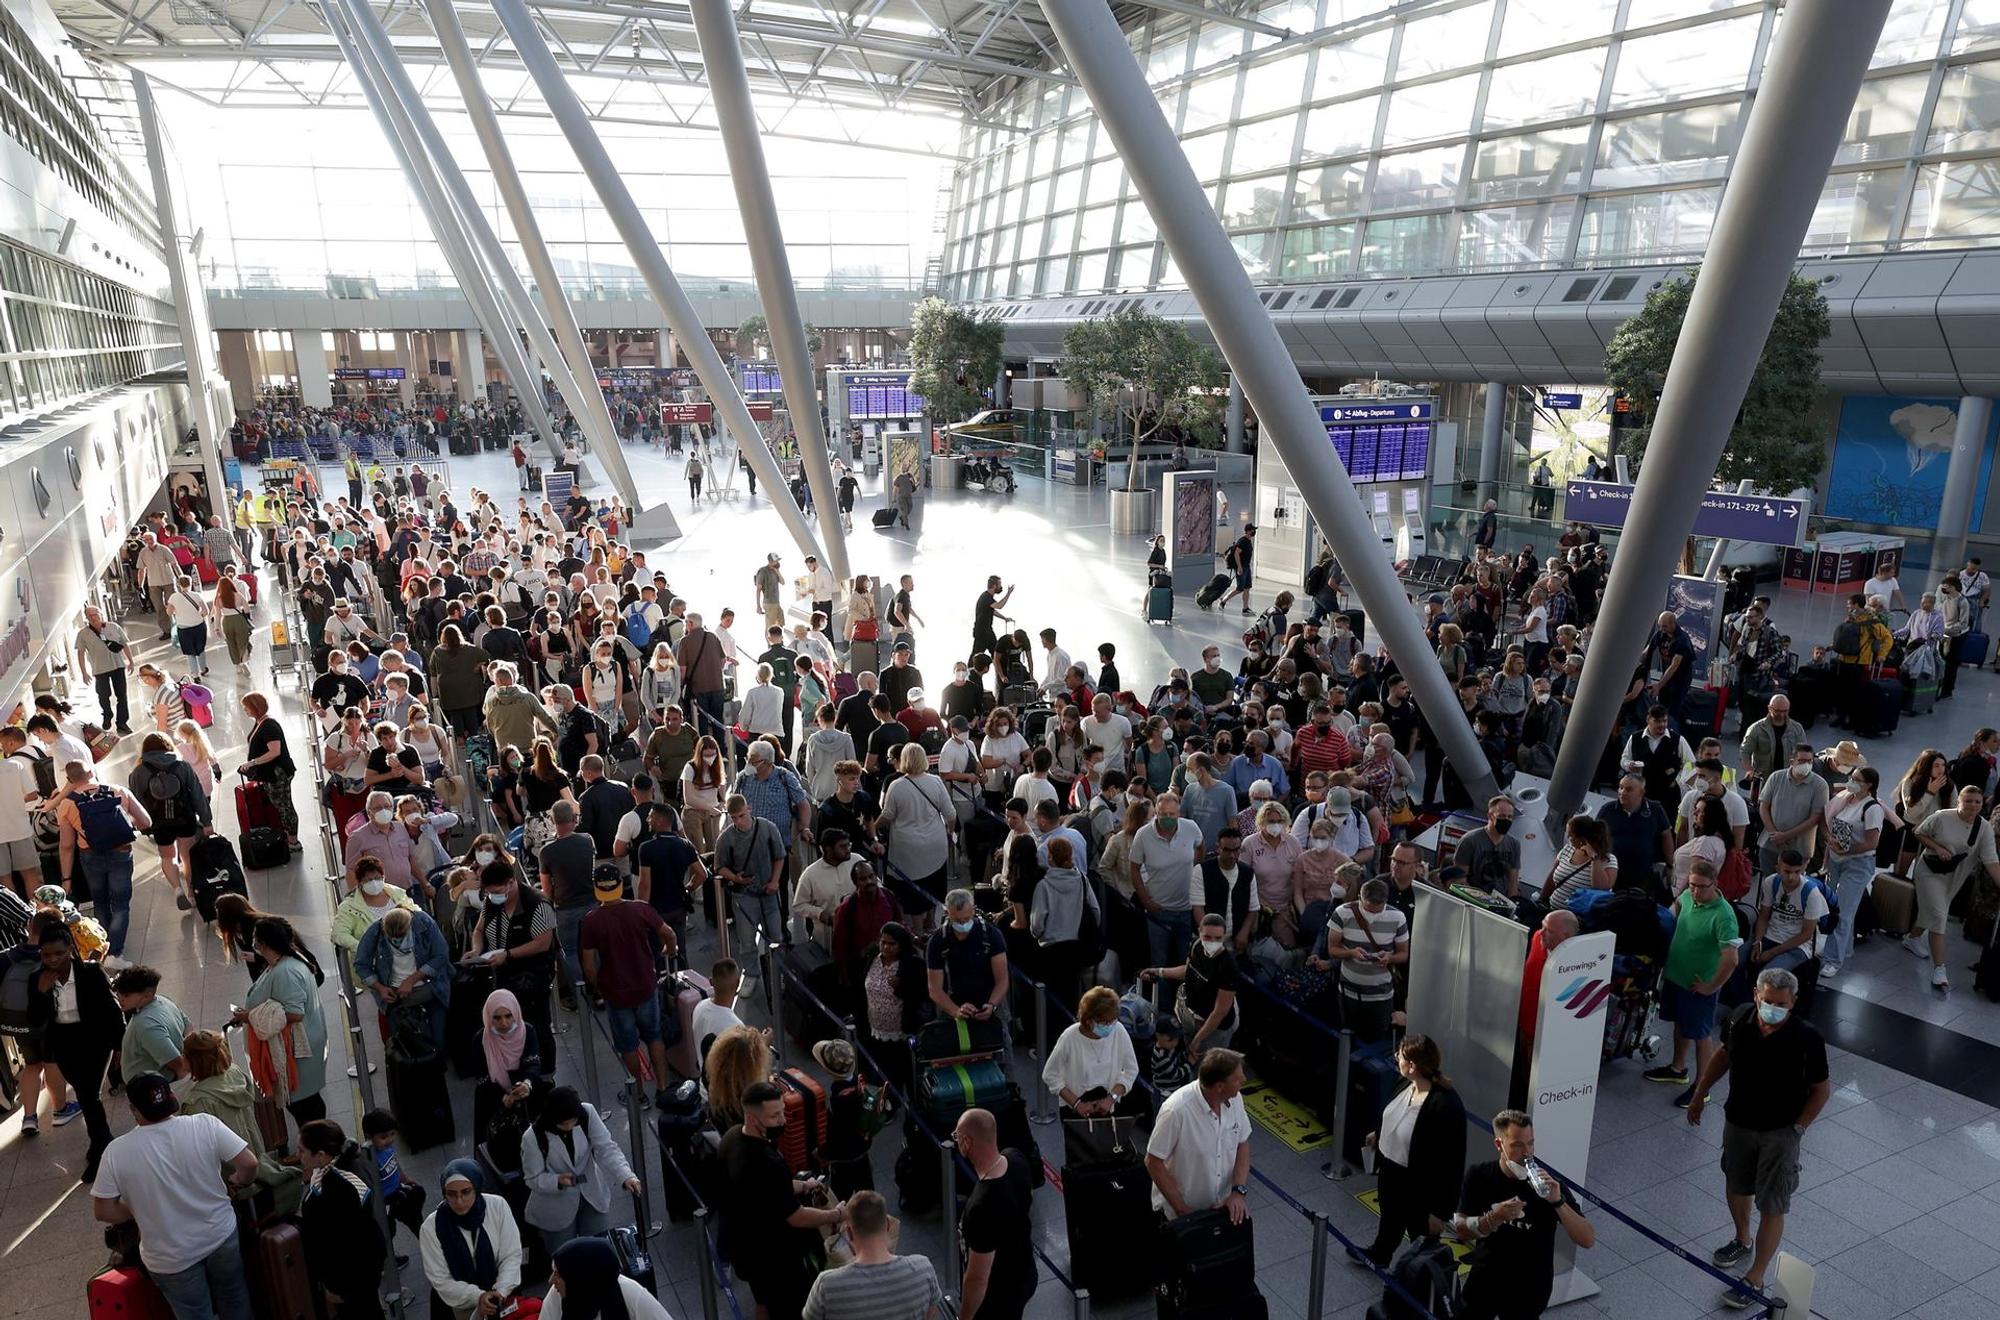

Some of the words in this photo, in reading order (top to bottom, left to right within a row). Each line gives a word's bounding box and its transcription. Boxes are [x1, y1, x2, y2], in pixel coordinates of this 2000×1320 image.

[1599, 489, 1629, 499] Check-in
[1558, 961, 1597, 974] Eurowings
[1539, 1084, 1593, 1106] Check-in
